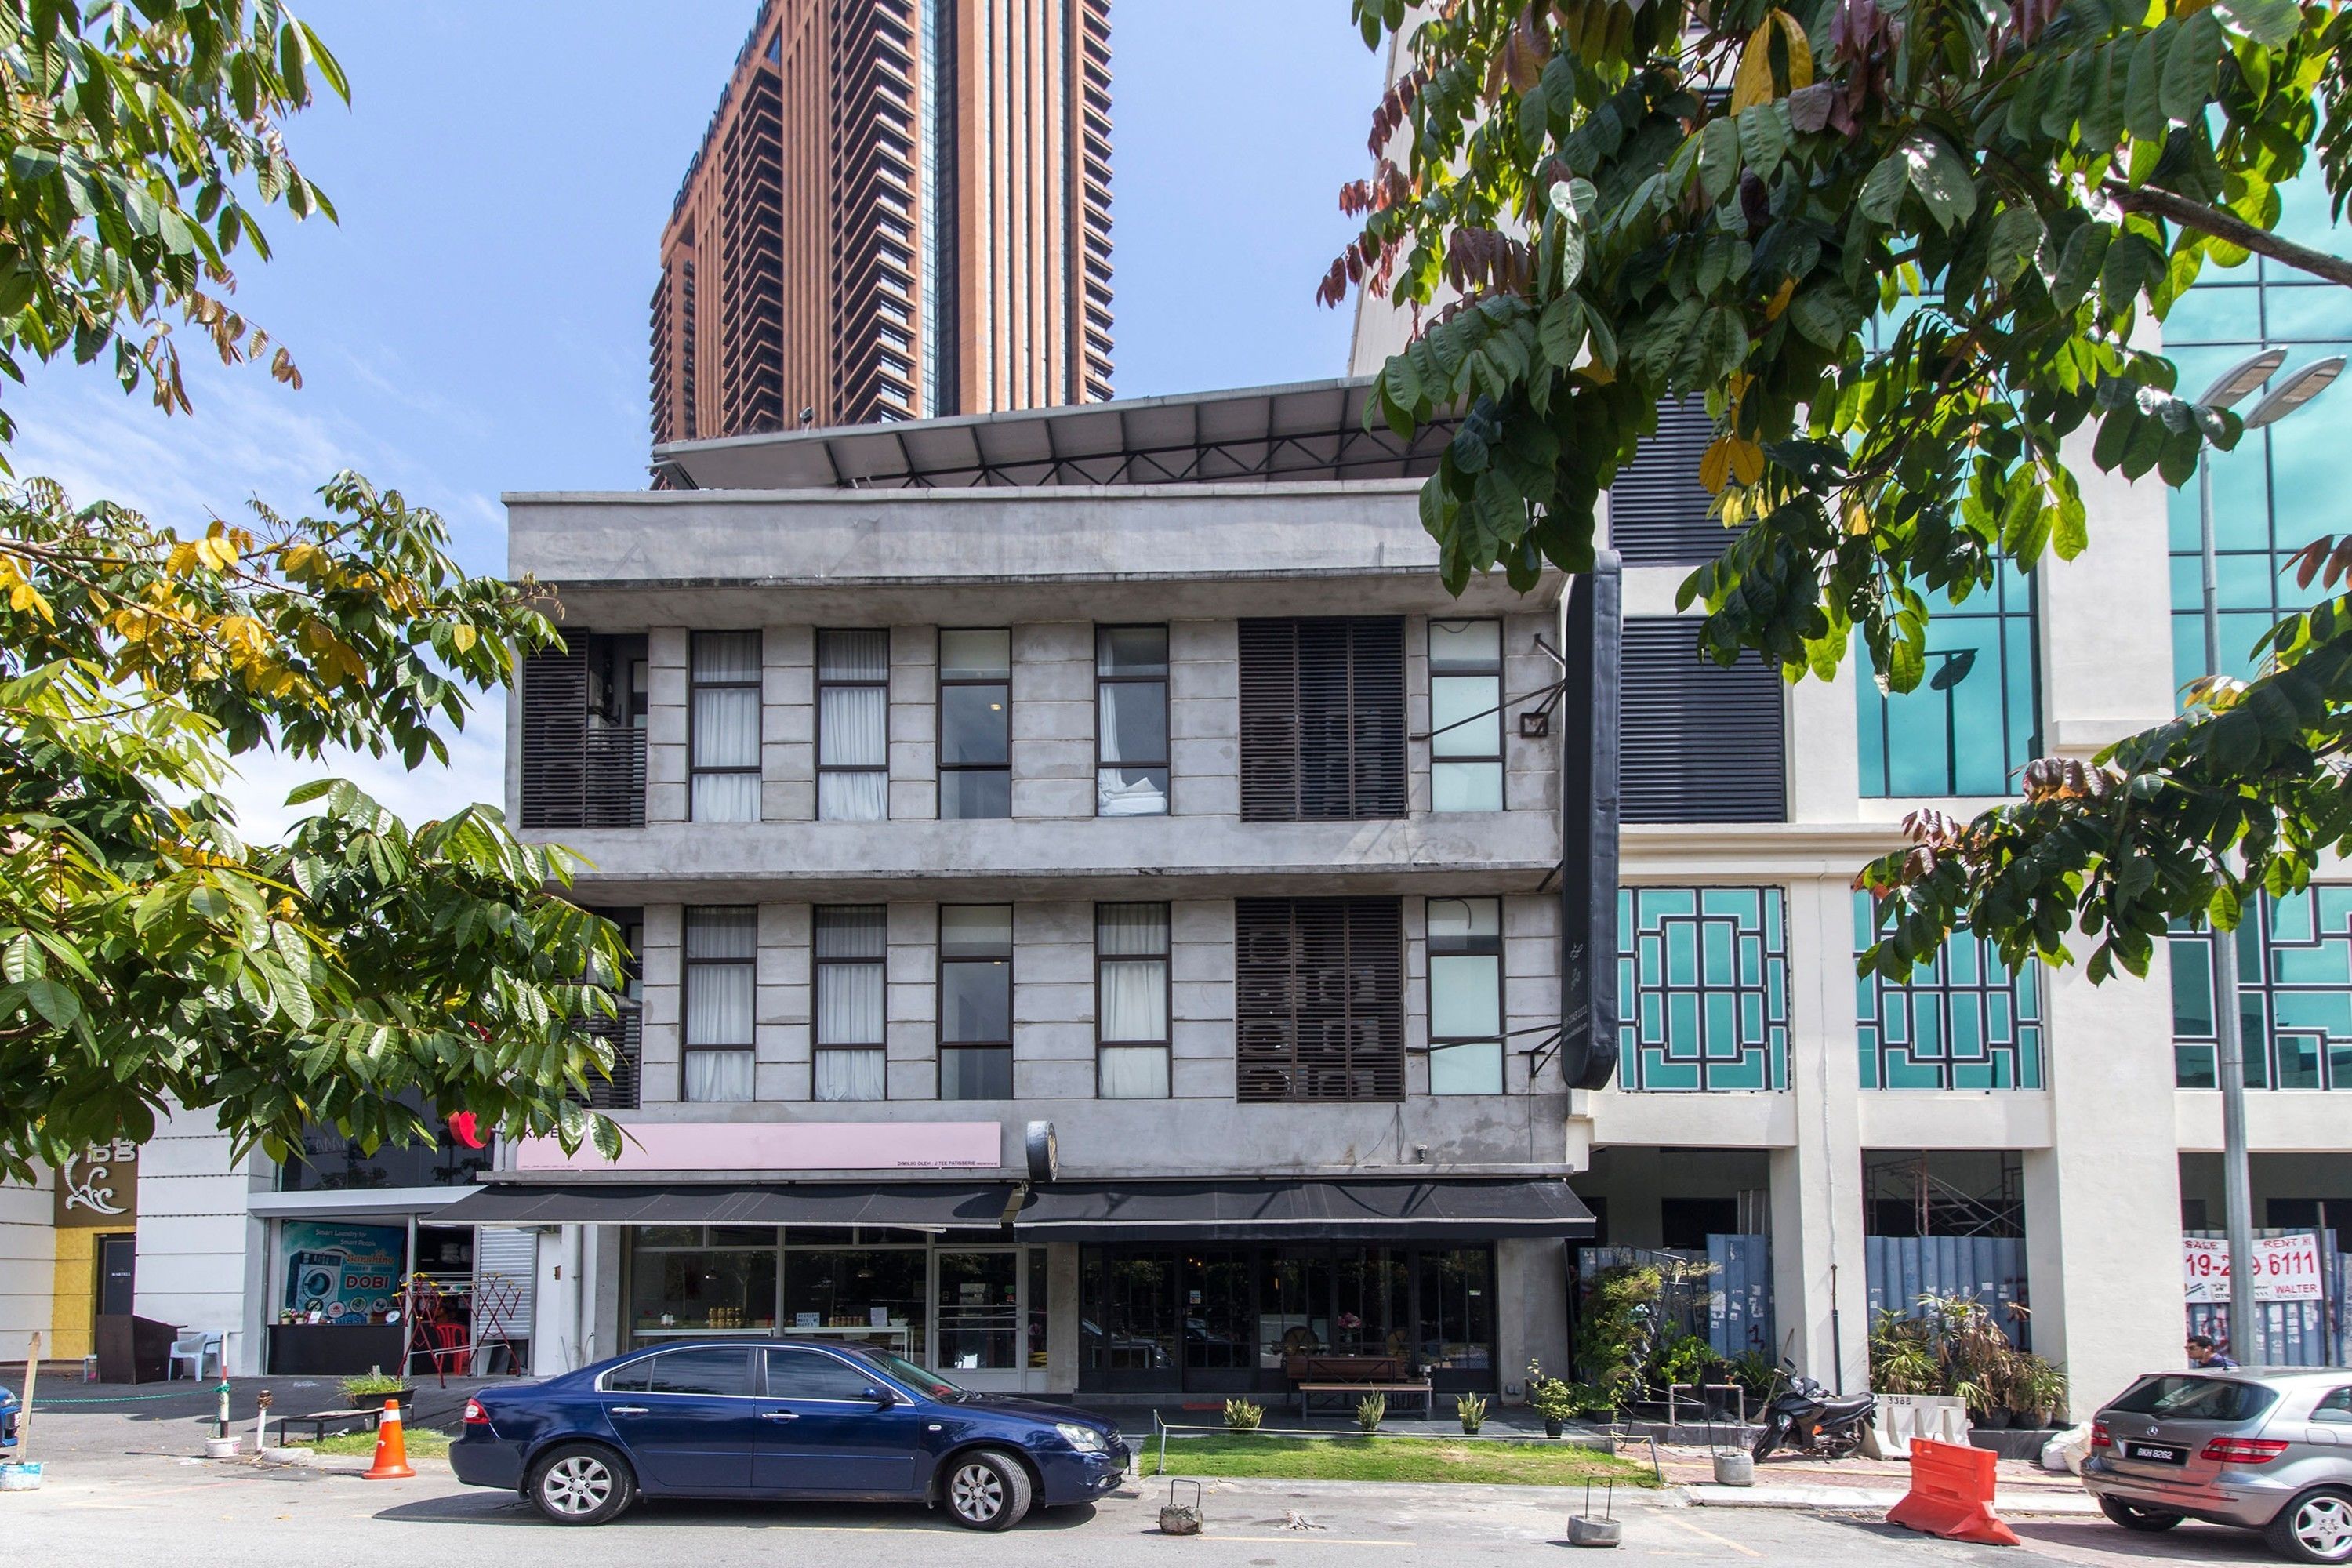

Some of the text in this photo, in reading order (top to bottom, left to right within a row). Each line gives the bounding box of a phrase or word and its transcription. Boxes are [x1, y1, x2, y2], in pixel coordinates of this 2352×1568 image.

[2184, 1240, 2219, 1250] SALE
[2263, 1238, 2298, 1248] RENT
[2268, 1250, 2314, 1276] 6111
[346, 1275, 389, 1289] DOBI
[2274, 1283, 2318, 1294] WALTER
[2153, 1450, 2172, 1460] 8262
